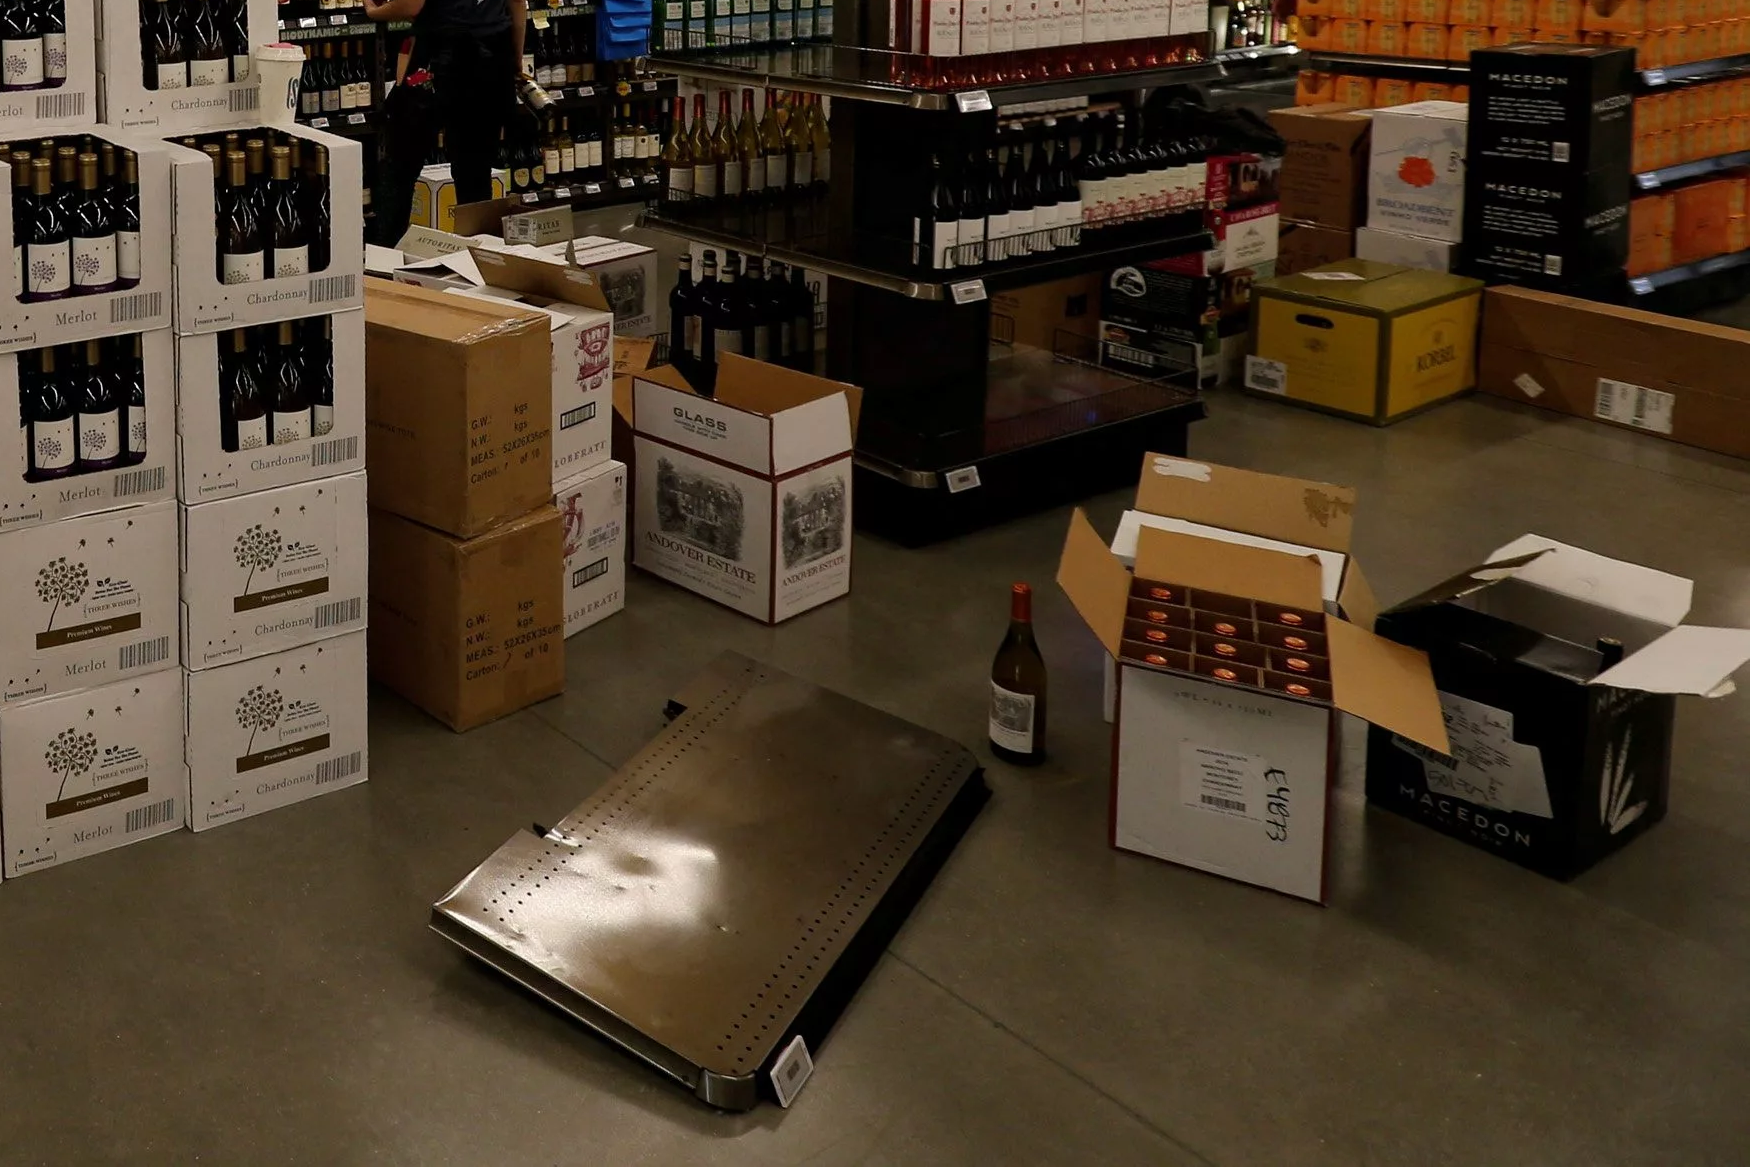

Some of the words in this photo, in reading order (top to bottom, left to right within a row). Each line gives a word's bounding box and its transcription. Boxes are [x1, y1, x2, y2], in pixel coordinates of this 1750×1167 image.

[280, 25, 340, 40] BIODYNAMIC
[1488, 72, 1569, 86] MACEDON
[171, 98, 227, 112] Chardonnay
[1484, 180, 1563, 201] MACEDON
[537, 219, 560, 230] RITAS
[418, 235, 461, 251] AUTORITAS
[247, 289, 307, 305] Chardonnay
[56, 310, 98, 326] Merlot
[1416, 344, 1457, 373] KORBEL
[514, 401, 528, 415] kgs
[513, 419, 528, 433] kgs
[673, 407, 727, 433] GLASS
[503, 429, 550, 454] 52X26X35cm
[250, 452, 312, 471] Chardonnay
[520, 452, 529, 465] of
[554, 440, 607, 468] LOBERATI
[59, 487, 101, 503] Merlot
[646, 531, 704, 562] ANDOVER
[706, 553, 755, 585] ESTATE
[782, 565, 818, 586] ANDOVER
[818, 555, 846, 573] ESTATE
[517, 599, 534, 612] kgs
[254, 616, 314, 636] Chardonnay
[516, 615, 534, 629] kgs
[504, 623, 561, 650] 52X26X35cm
[525, 647, 534, 659] of
[538, 643, 549, 654] 10
[65, 659, 107, 676] Merlot
[256, 772, 315, 795] Chardonnay
[1399, 782, 1531, 849] MACEDON
[73, 825, 113, 844] Merlot
